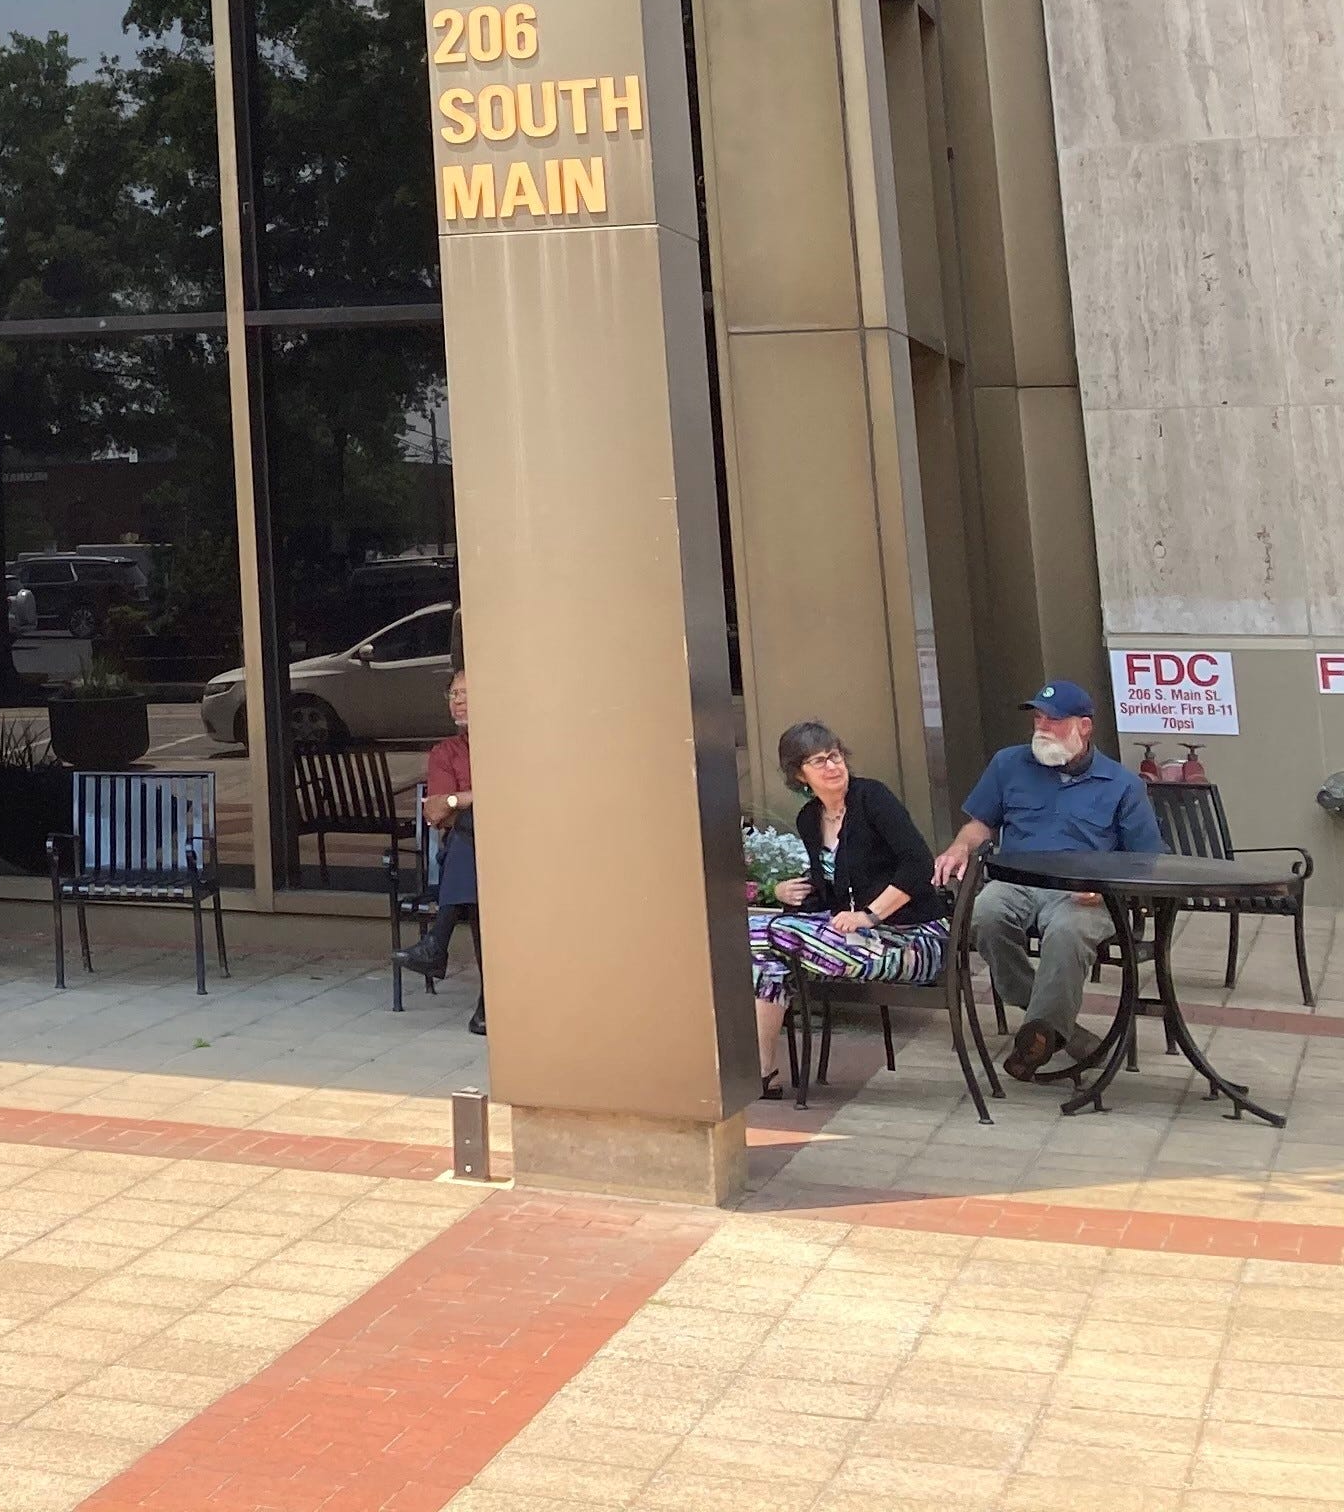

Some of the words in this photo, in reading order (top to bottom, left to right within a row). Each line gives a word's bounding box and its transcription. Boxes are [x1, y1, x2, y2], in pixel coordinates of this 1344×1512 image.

[433, 3, 537, 64] 206
[439, 75, 643, 144] SOUTH
[443, 157, 607, 220] MAIN
[1126, 654, 1219, 686] FDC
[1128, 689, 1151, 700] 206
[1155, 689, 1166, 700] S.
[1172, 690, 1201, 701] Main
[1162, 717, 1194, 731] 70psi
